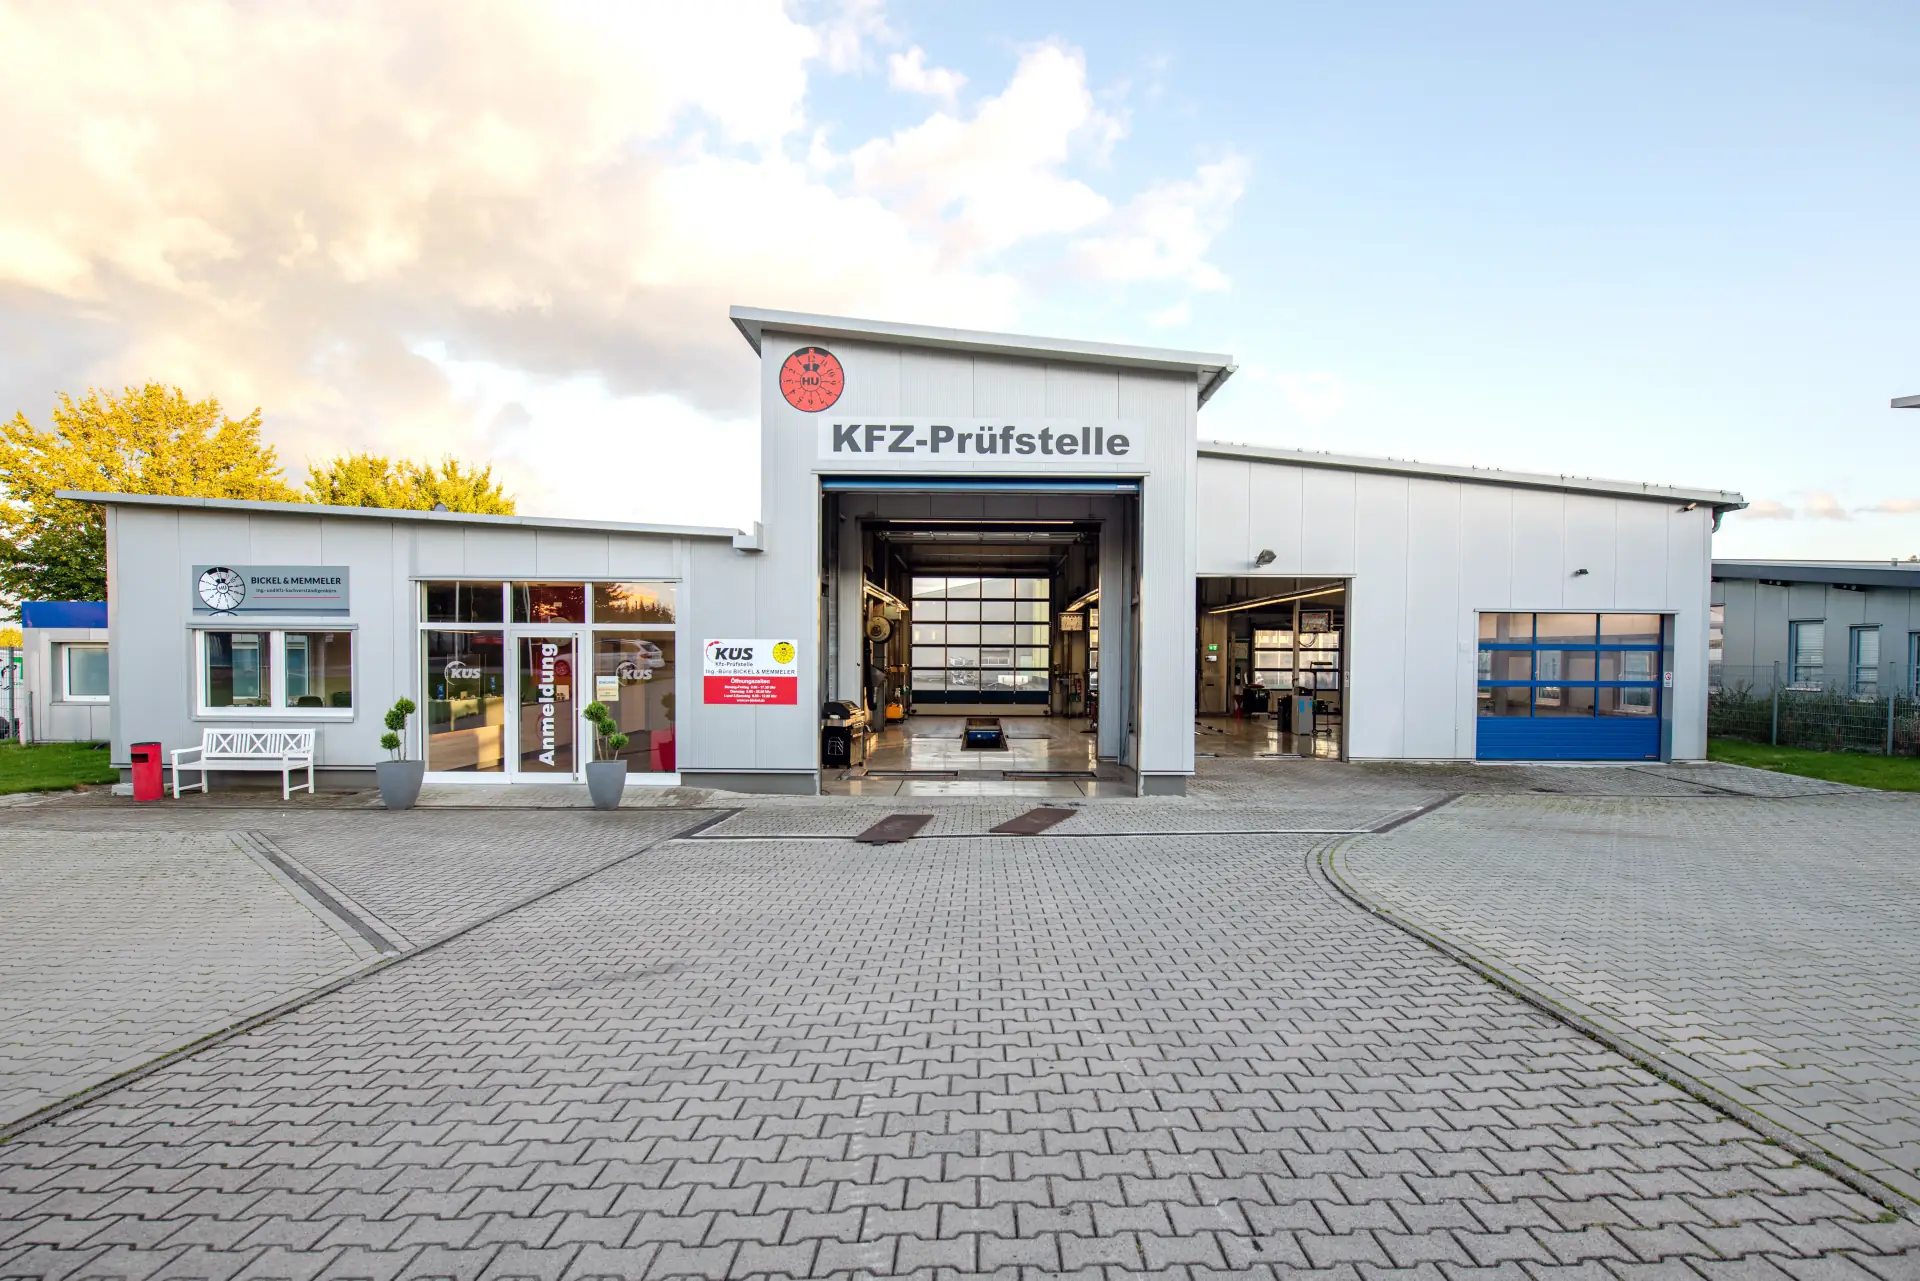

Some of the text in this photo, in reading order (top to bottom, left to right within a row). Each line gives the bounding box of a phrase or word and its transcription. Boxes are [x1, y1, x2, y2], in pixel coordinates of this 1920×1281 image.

[802, 377, 819, 386] HU
[832, 424, 1131, 456] KFZ-Prüfstelle
[251, 577, 281, 585] BICKEL
[291, 577, 341, 585] MEMMELER
[715, 647, 753, 660] KÜS
[538, 643, 559, 767] Anmeldung
